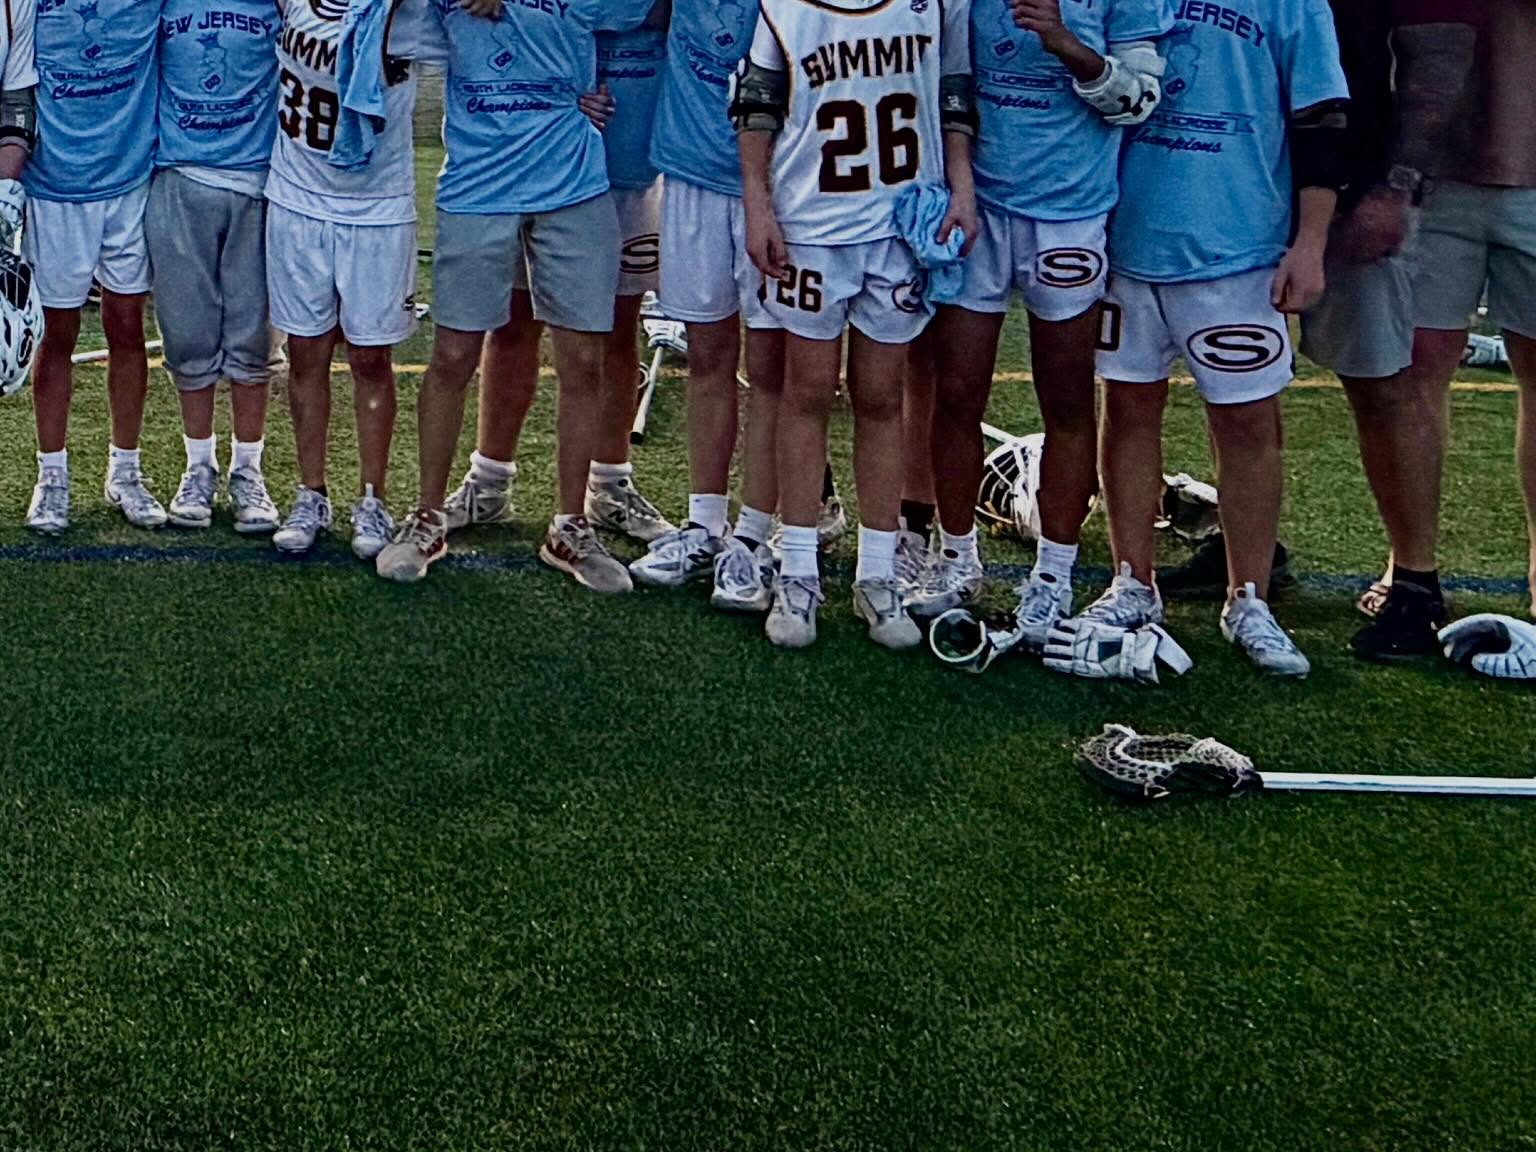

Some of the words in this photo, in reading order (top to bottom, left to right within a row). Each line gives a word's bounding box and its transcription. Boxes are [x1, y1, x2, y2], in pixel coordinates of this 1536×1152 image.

[165, 13, 193, 40] EW
[198, 11, 273, 38] JERSEY
[1173, 0, 1265, 47] JERSEY
[800, 33, 932, 89] SUMMIT
[278, 67, 340, 150] 38
[816, 92, 920, 193] 26
[775, 263, 823, 313] 26
[1041, 251, 1093, 283] S
[1202, 329, 1270, 366] S
